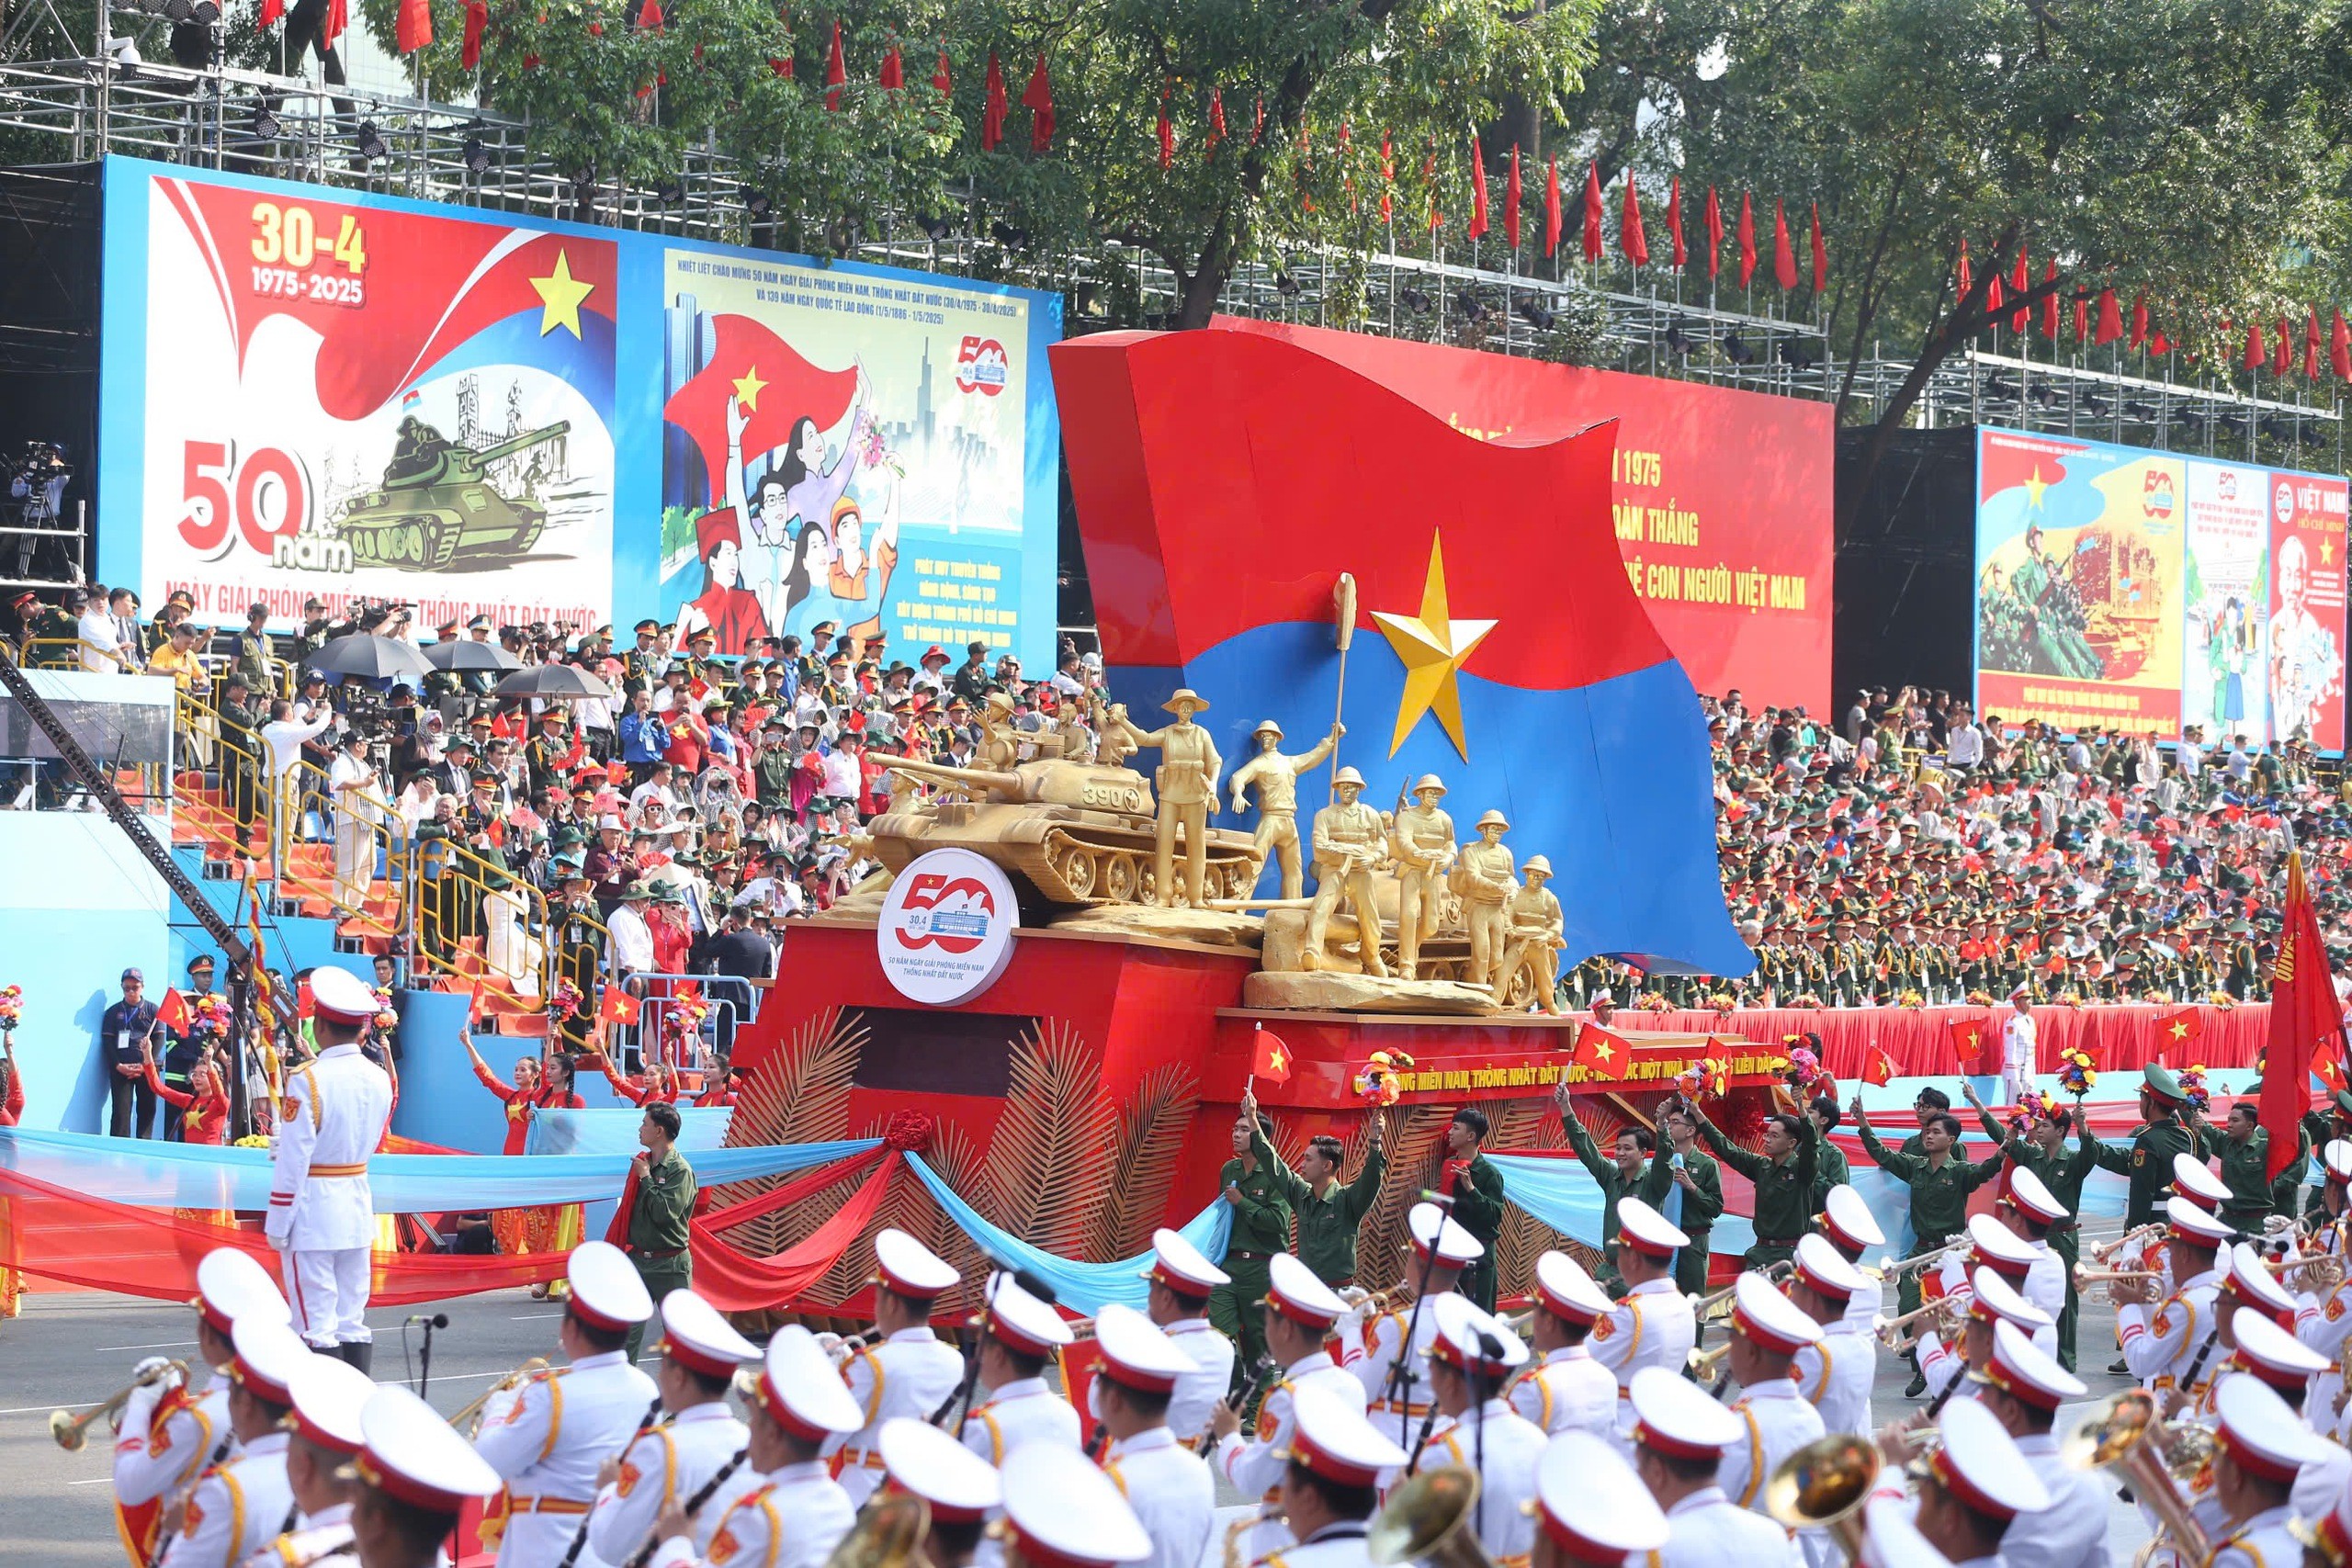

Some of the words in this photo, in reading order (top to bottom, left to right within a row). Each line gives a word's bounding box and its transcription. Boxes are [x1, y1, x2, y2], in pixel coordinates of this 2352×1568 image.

[252, 202, 366, 274] 30-4
[752, 269, 762, 283] 50
[767, 290, 779, 302] 139
[912, 310, 944, 325] 1/5/2025)
[1623, 449, 1661, 487] 1975
[177, 439, 304, 556] 50
[2297, 483, 2322, 514] VIỆT
[1648, 497, 1699, 546] THẮNG
[273, 528, 356, 574] năm
[1647, 564, 1679, 601] CON
[1684, 562, 1731, 604] NGƯỜI
[1736, 566, 1767, 614] VIỆT
[1771, 575, 1804, 610] NAM
[1082, 783, 1121, 807] 390
[910, 915, 926, 925] 30.4
[888, 956, 895, 964] 50
[937, 959, 957, 970] PHÓNG
[970, 964, 985, 972] NAM
[1417, 1066, 1442, 1091] MIỀN
[1472, 1064, 1507, 1089] THỐNG
[1508, 1062, 1537, 1087] NHẤT
[1538, 1060, 1559, 1085] ĐẤT
[1639, 1057, 1661, 1082] MỘT
[1735, 1051, 1755, 1075] LIỀN
